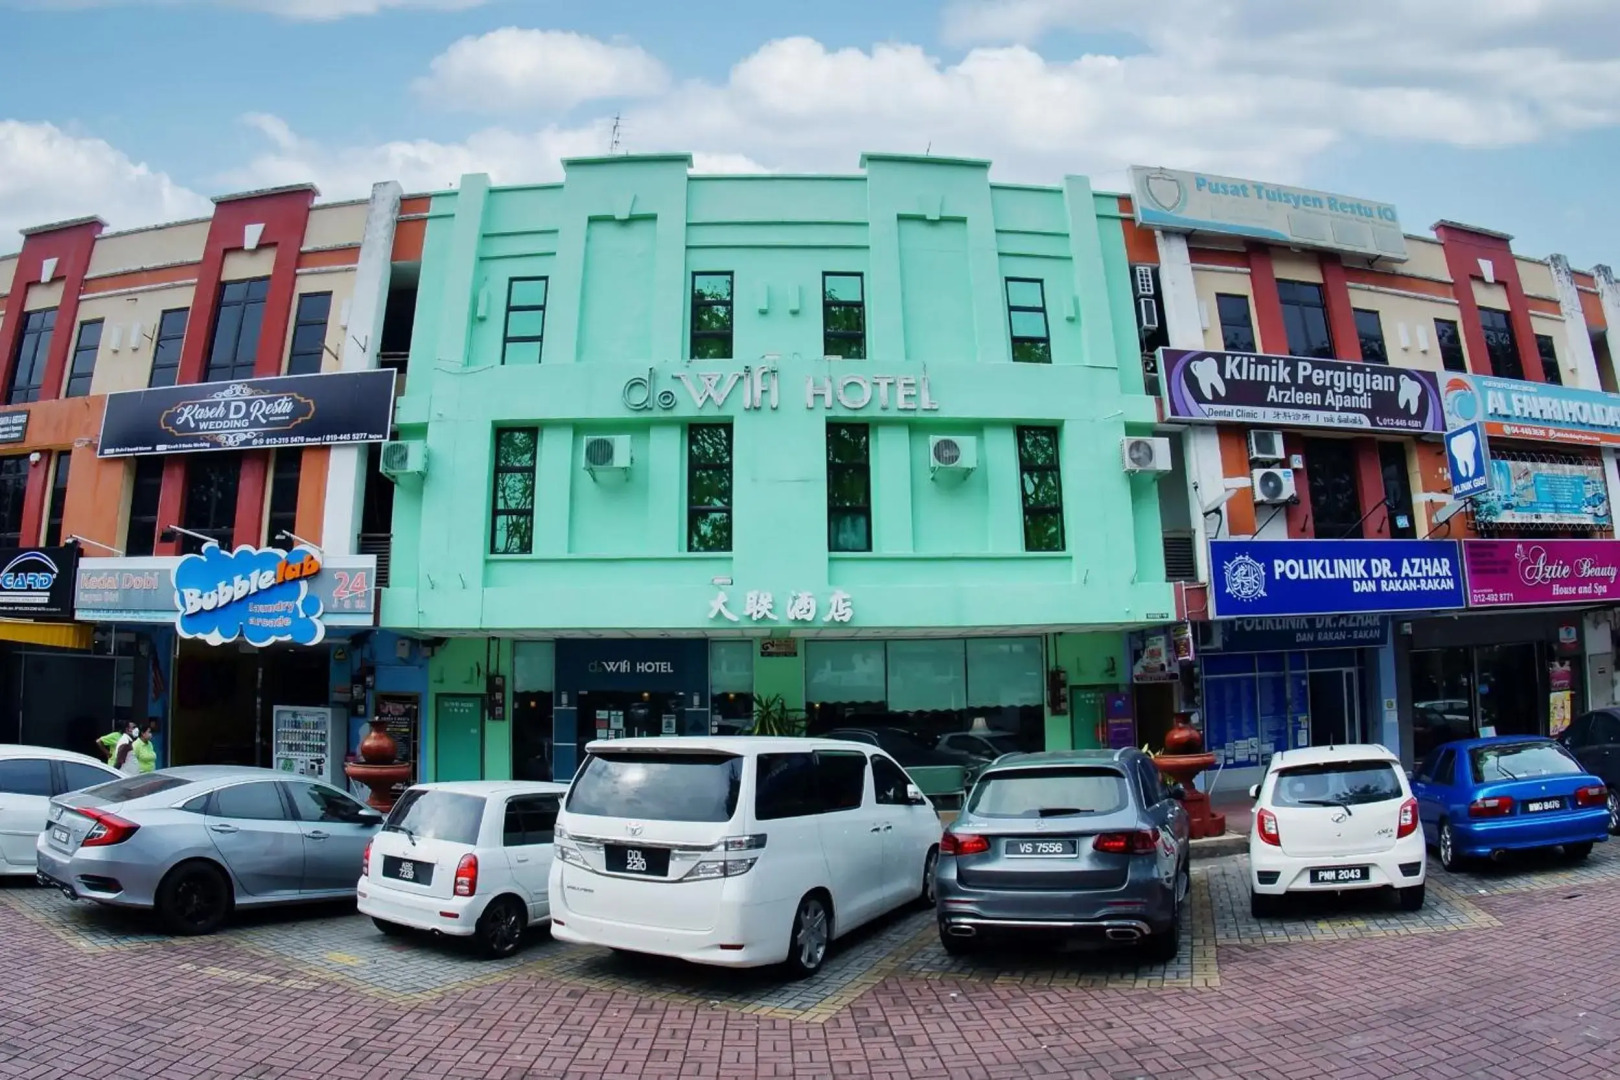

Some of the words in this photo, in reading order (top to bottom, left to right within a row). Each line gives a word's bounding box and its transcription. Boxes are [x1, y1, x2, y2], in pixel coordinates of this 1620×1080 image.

[1195, 176, 1250, 198] Pusat
[1252, 184, 1324, 209] Tuisyen
[1327, 196, 1375, 218] Restu
[1224, 355, 1291, 384] Klinik
[1297, 361, 1396, 395] Pergigian
[805, 373, 939, 411] HOTEL
[1266, 384, 1321, 407] Arzleen
[1325, 388, 1372, 411] Apandi
[176, 401, 227, 428] Kaseh
[229, 401, 247, 419] D
[250, 396, 295, 424] Restu
[1207, 407, 1234, 419] Dental
[1235, 408, 1258, 420] Clinic
[198, 418, 249, 430] WEDDING
[1453, 481, 1473, 495] KLINIK
[1472, 475, 1487, 488] GIGI
[1273, 558, 1369, 580] POLIKLINIK
[1371, 558, 1398, 578] DR.
[1401, 557, 1452, 578] AZHAR
[1573, 556, 1618, 583] Beauty
[122, 571, 160, 590] Dobi
[332, 571, 368, 598] 24
[1353, 579, 1377, 593] DAN
[1381, 578, 1455, 592] RAKAN-RAKAN
[1552, 584, 1576, 596] House
[1578, 582, 1593, 594] and
[1593, 582, 1607, 596] Spa
[1295, 632, 1314, 643] DAN
[636, 661, 674, 673] HOTEL
[1019, 843, 1033, 853] VS
[1036, 842, 1063, 853] 7556
[1338, 868, 1361, 879] 2043
